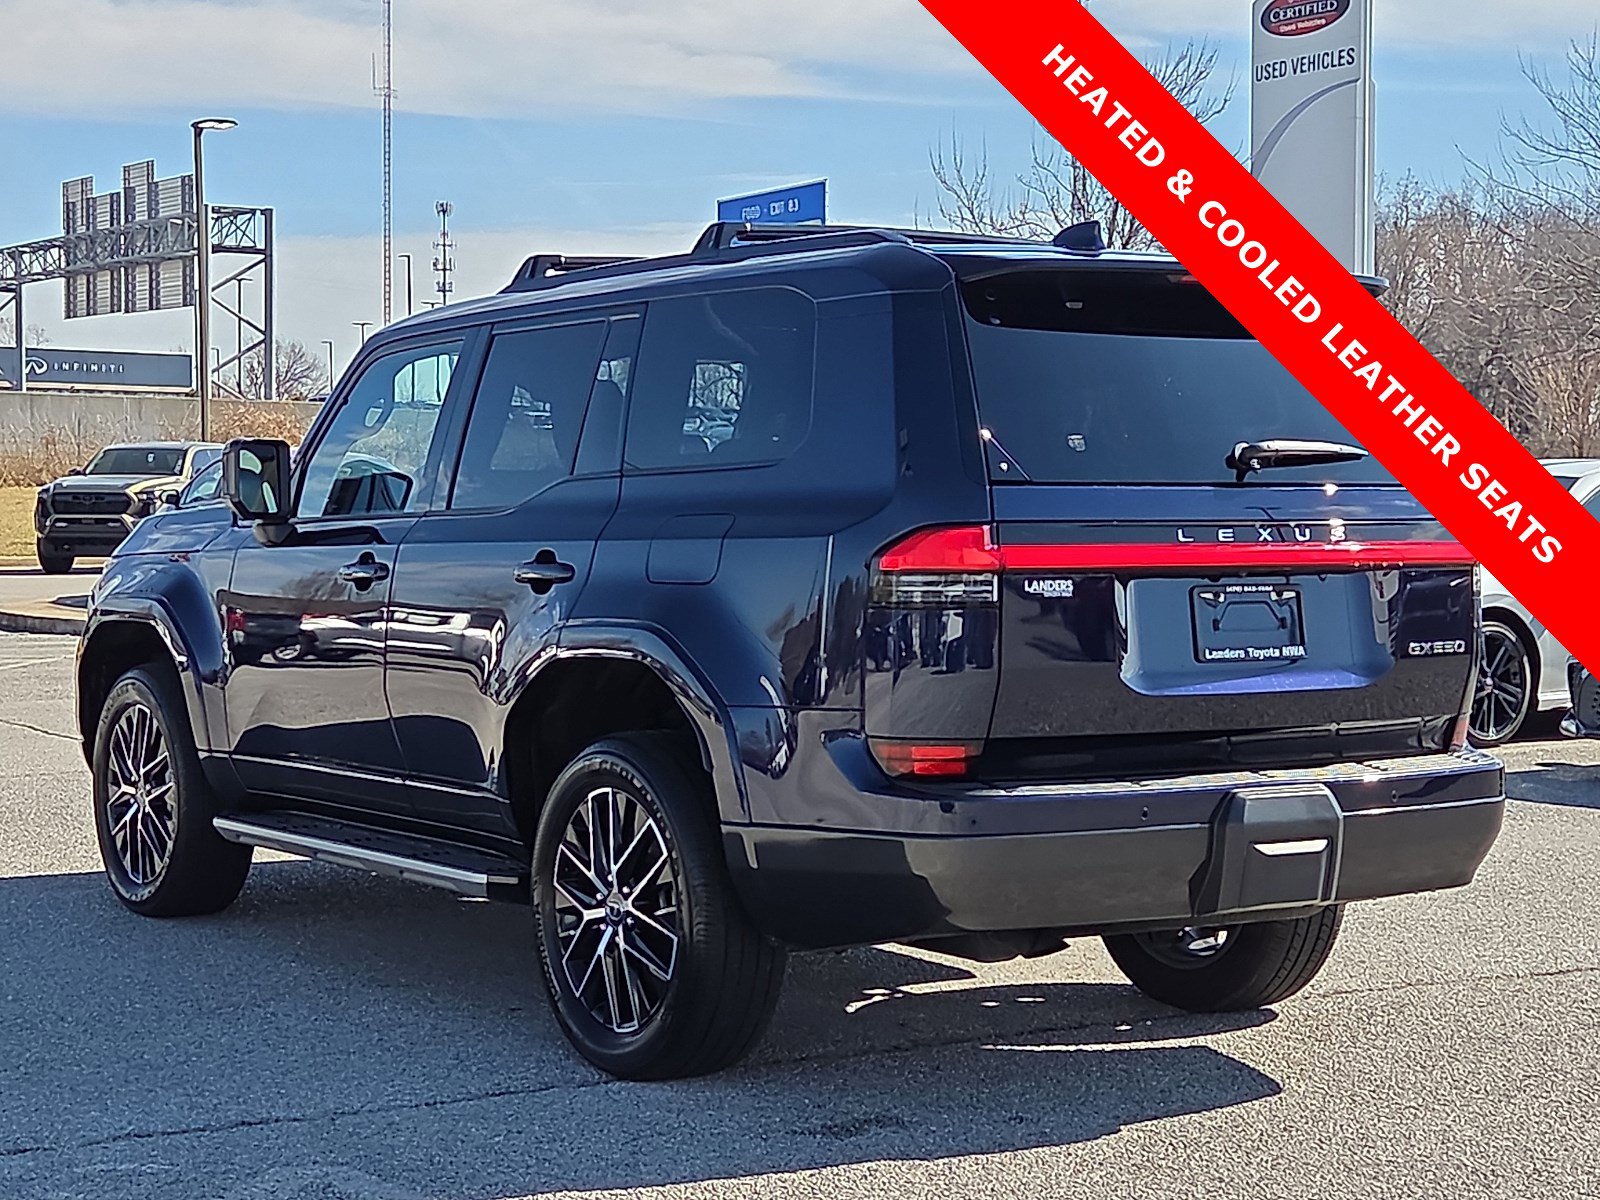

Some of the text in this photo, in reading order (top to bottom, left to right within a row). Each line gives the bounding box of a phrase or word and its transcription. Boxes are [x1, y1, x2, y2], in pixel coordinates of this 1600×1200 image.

[1269, 0, 1338, 22] CERTIFIED
[1255, 47, 1356, 82] USED VEHICLES
[52, 361, 125, 374] INFINITI
[1177, 525, 1347, 542] LEXUS
[1024, 579, 1074, 592] LANDERS
[1205, 645, 1306, 659] Landers Toyota NWA
